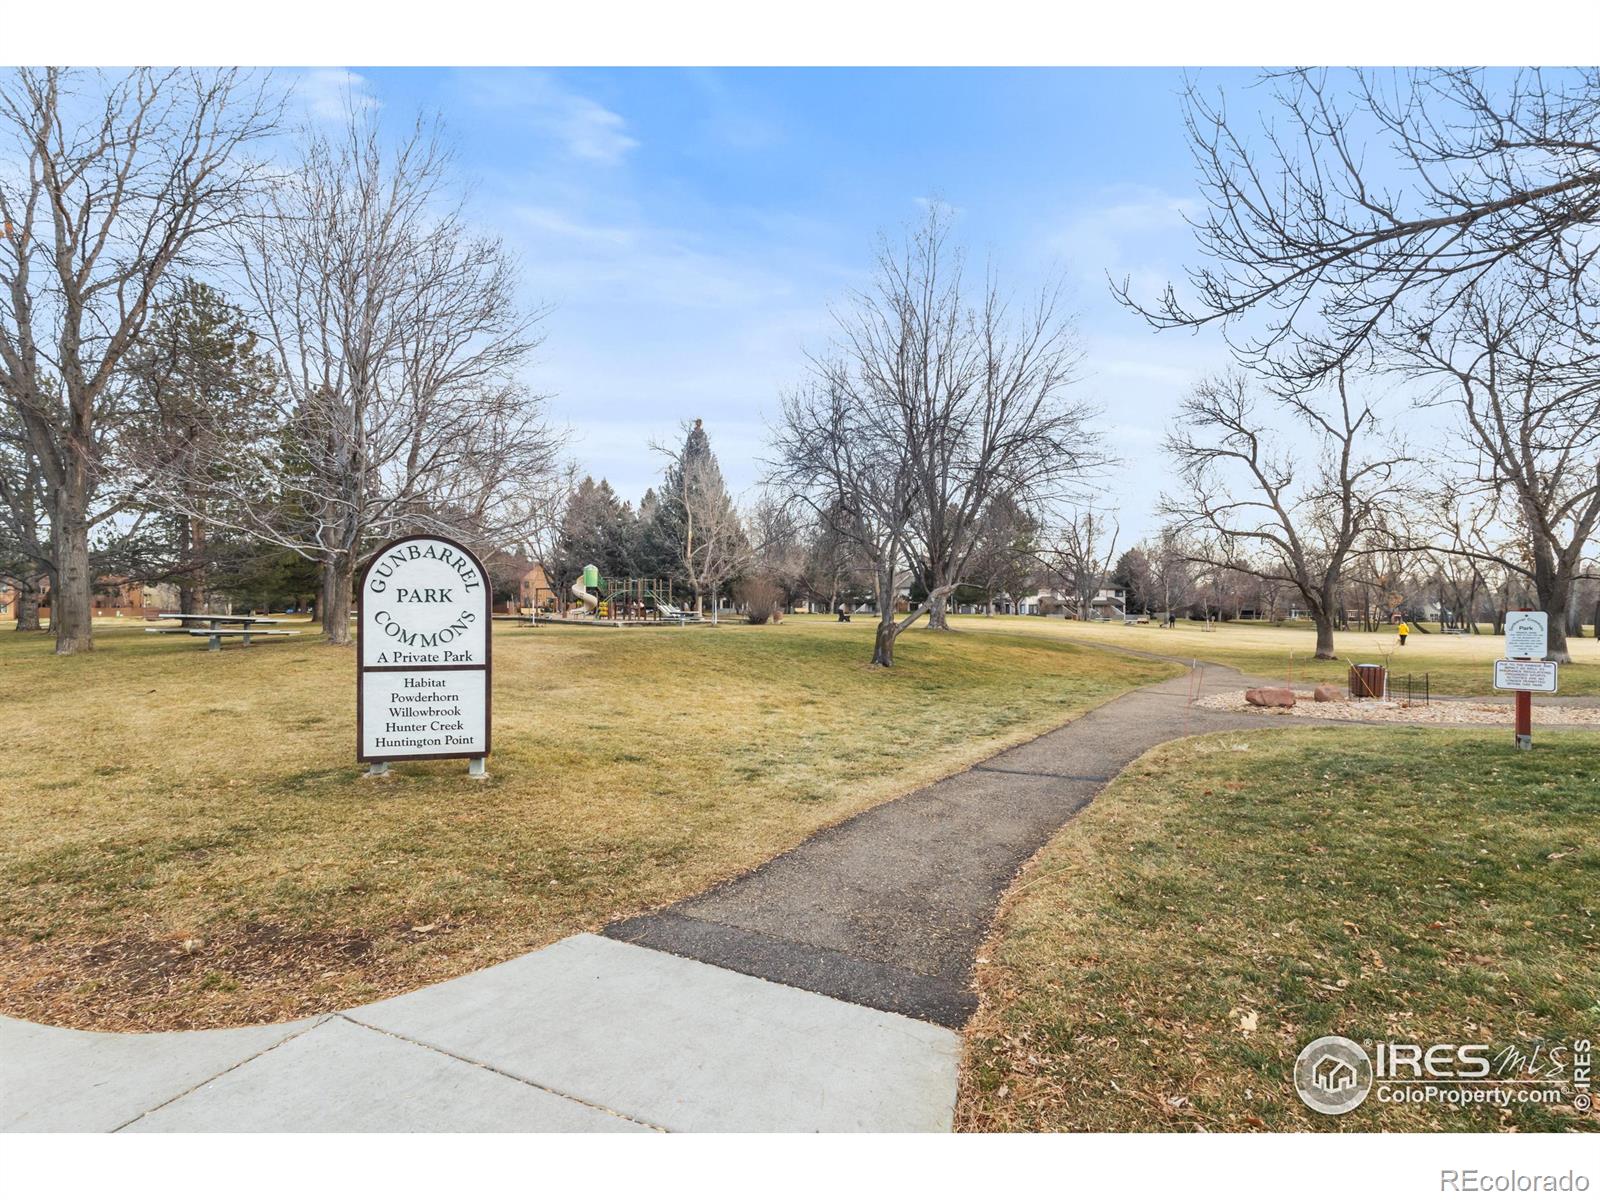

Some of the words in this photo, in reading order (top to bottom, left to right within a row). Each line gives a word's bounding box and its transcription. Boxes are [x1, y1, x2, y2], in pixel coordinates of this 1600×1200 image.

[370, 545, 480, 593] GUNBARREL
[396, 588, 453, 603] PARK
[374, 610, 476, 648] COMMONS
[377, 652, 389, 663] A
[393, 651, 440, 663] Private
[443, 650, 473, 662] Park
[404, 678, 446, 688] Habitat
[391, 692, 459, 703] Powderhorn
[389, 706, 462, 718] Willowbrook
[386, 722, 427, 733] Hunter
[430, 720, 464, 731] Creek
[375, 737, 441, 749] Huntington
[445, 735, 474, 745] Point
